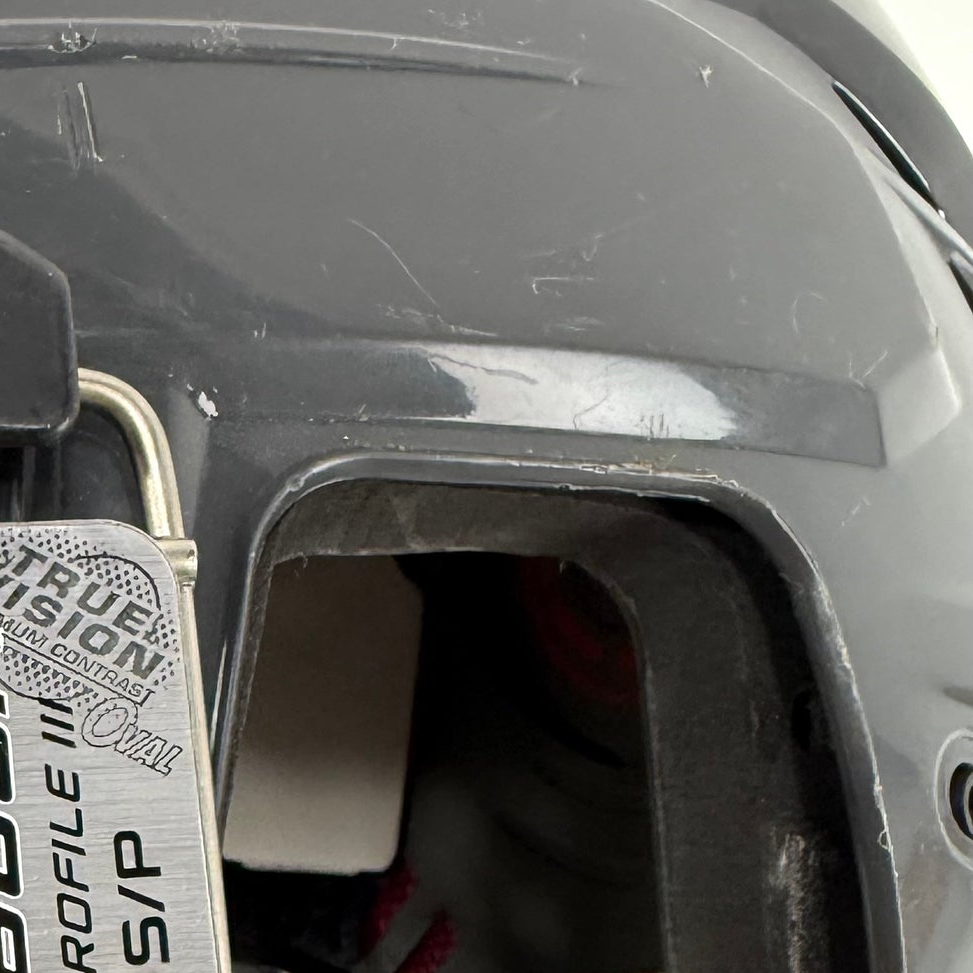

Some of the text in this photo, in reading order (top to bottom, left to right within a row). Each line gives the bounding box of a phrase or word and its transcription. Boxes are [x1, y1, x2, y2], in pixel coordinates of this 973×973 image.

[11, 544, 155, 635] TRUE
[50, 643, 156, 706] CONTRAST
[113, 830, 171, 965] S/P
